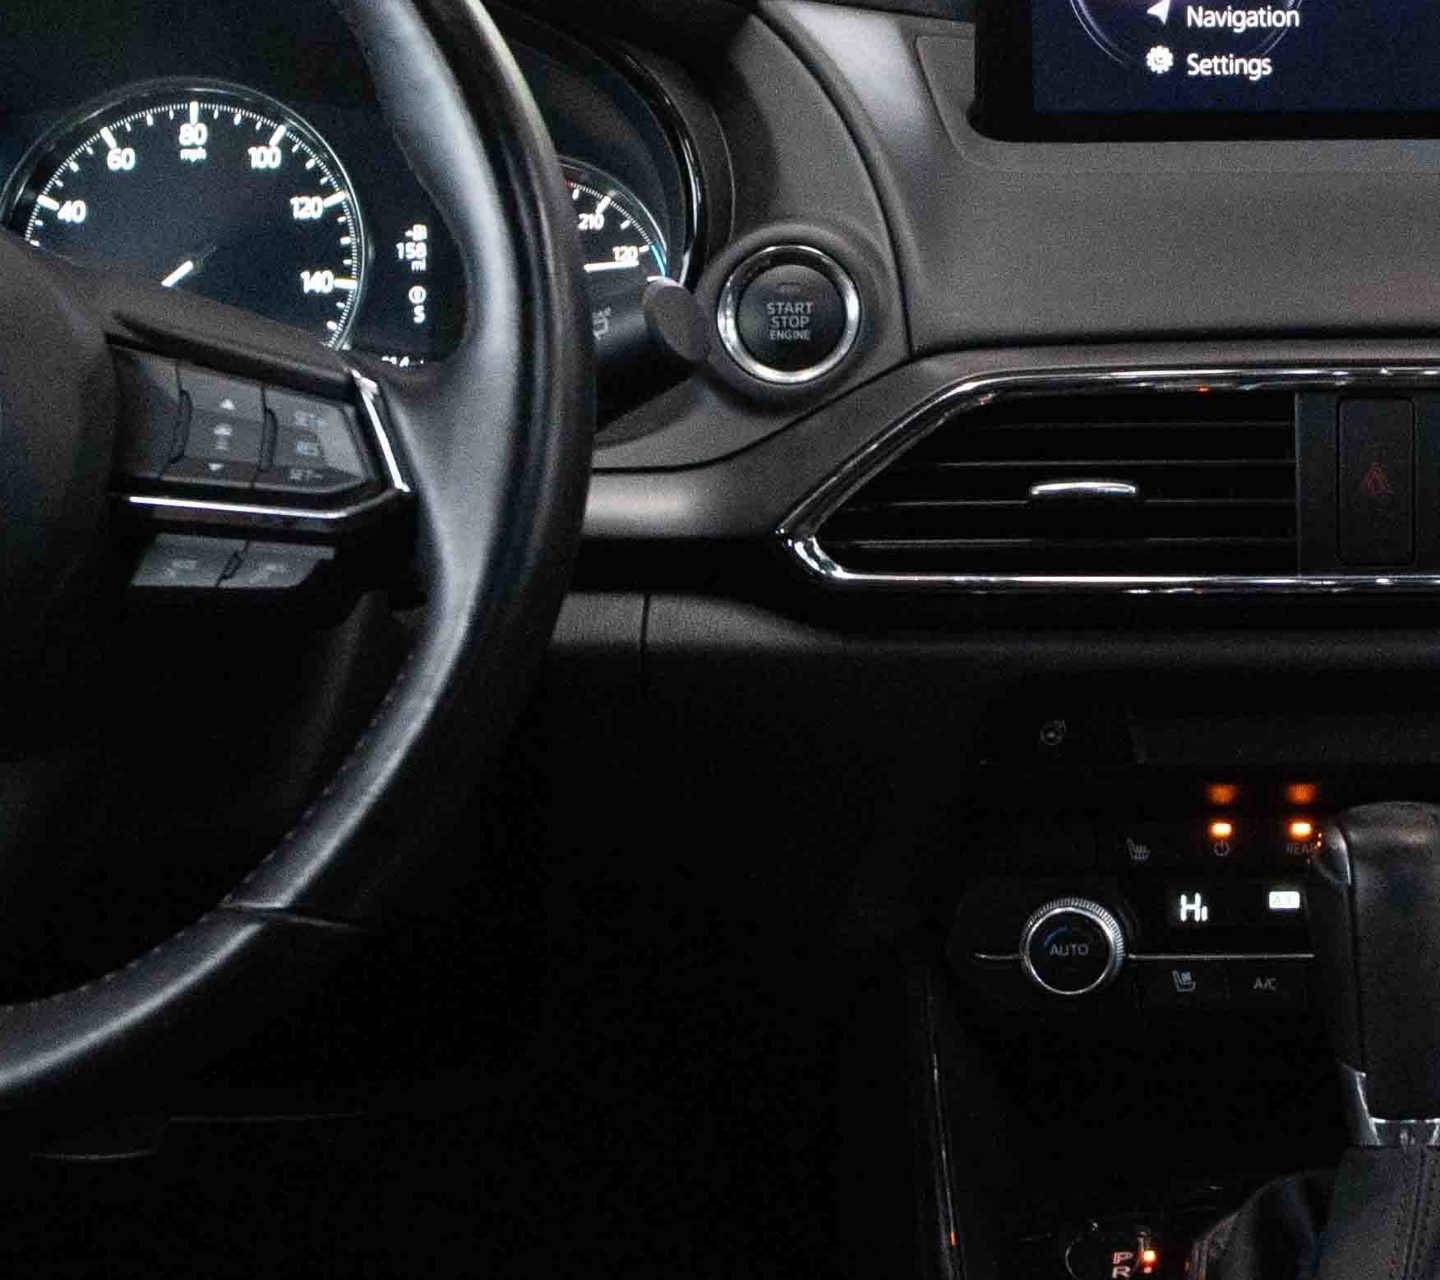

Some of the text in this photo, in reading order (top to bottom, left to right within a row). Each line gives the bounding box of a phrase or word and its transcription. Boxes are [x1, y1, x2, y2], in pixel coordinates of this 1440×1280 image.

[1186, 5, 1300, 33] Navigation
[1186, 53, 1272, 81] Settings
[179, 122, 208, 146] 80
[107, 147, 136, 171] 60
[248, 146, 282, 169] 100
[57, 199, 87, 223] 40
[290, 195, 324, 219] 120
[396, 242, 427, 260] 158
[612, 245, 639, 263] 120
[301, 269, 334, 294] 140
[766, 301, 814, 315] START
[771, 315, 810, 329] STOP
[769, 328, 811, 340] ENGINE
[1050, 943, 1089, 956] AUTO
[1112, 1251, 1133, 1264] P
[1112, 1265, 1131, 1280] R
